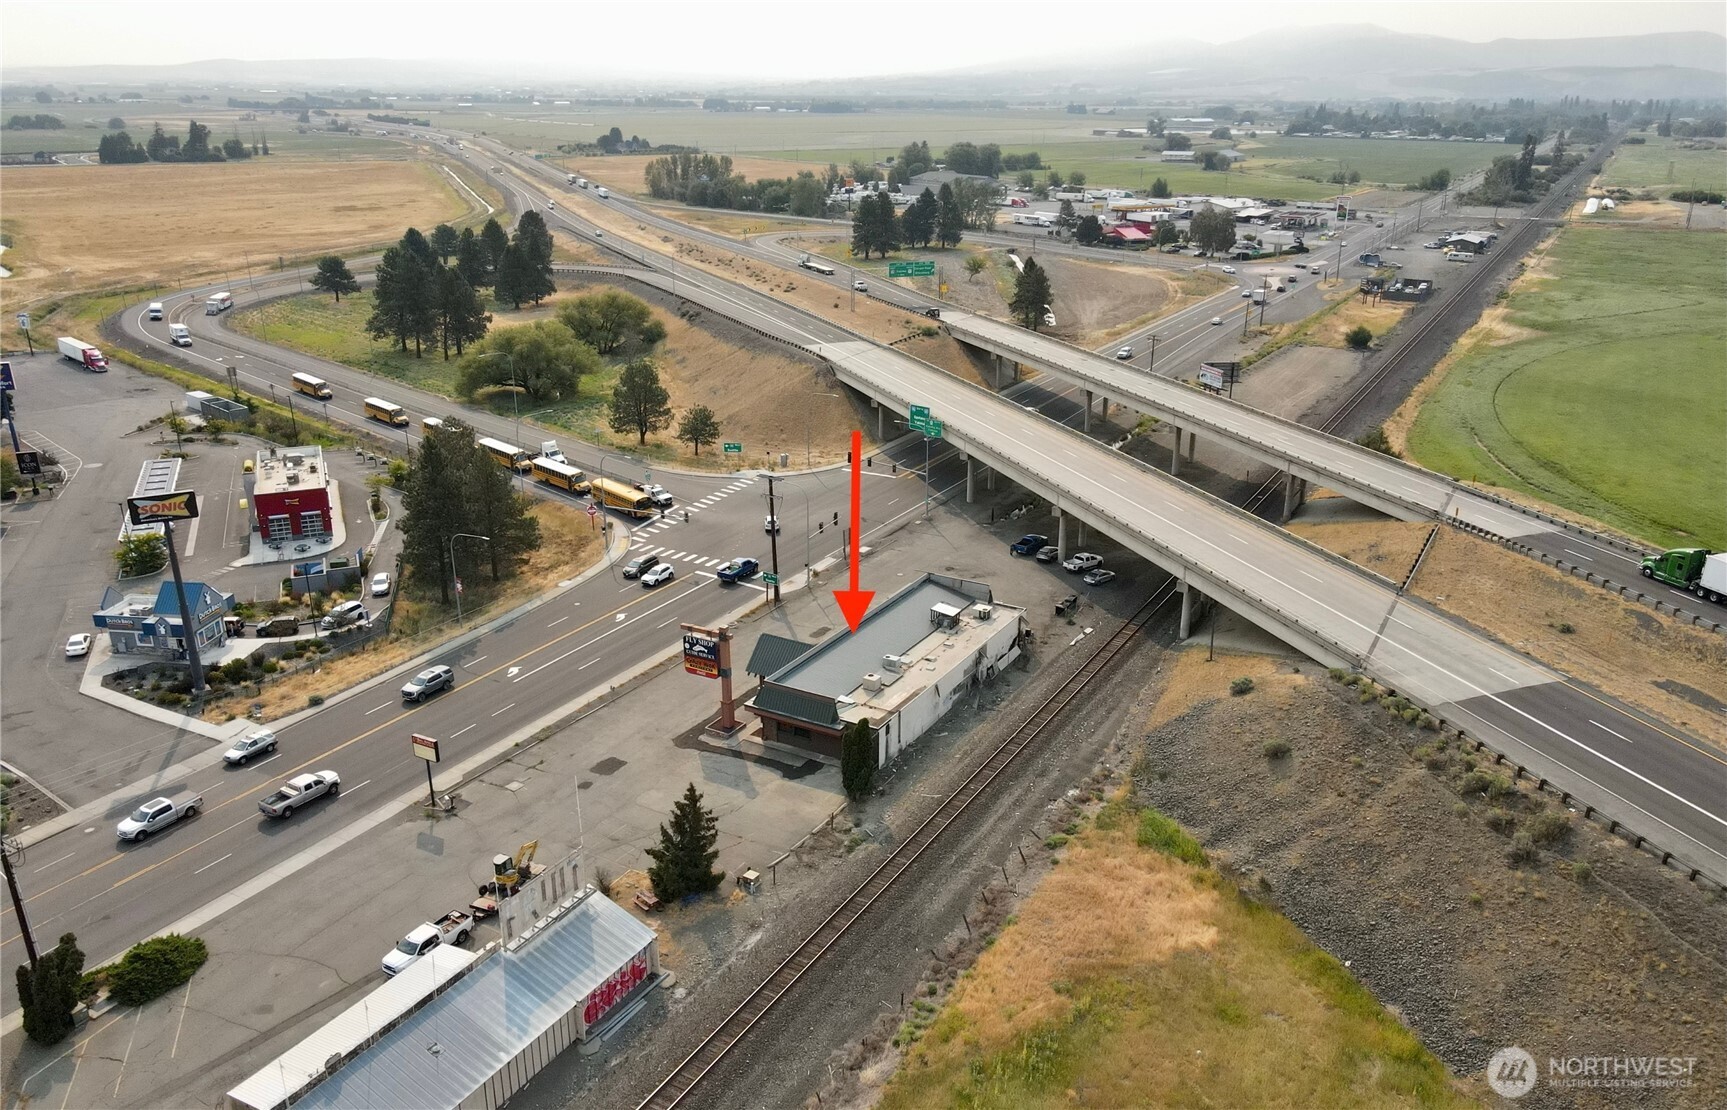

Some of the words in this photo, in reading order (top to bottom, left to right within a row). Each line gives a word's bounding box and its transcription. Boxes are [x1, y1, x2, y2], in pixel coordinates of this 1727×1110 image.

[140, 501, 186, 515] SONIC
[685, 636, 697, 644] FLY
[698, 639, 715, 648] SHOP
